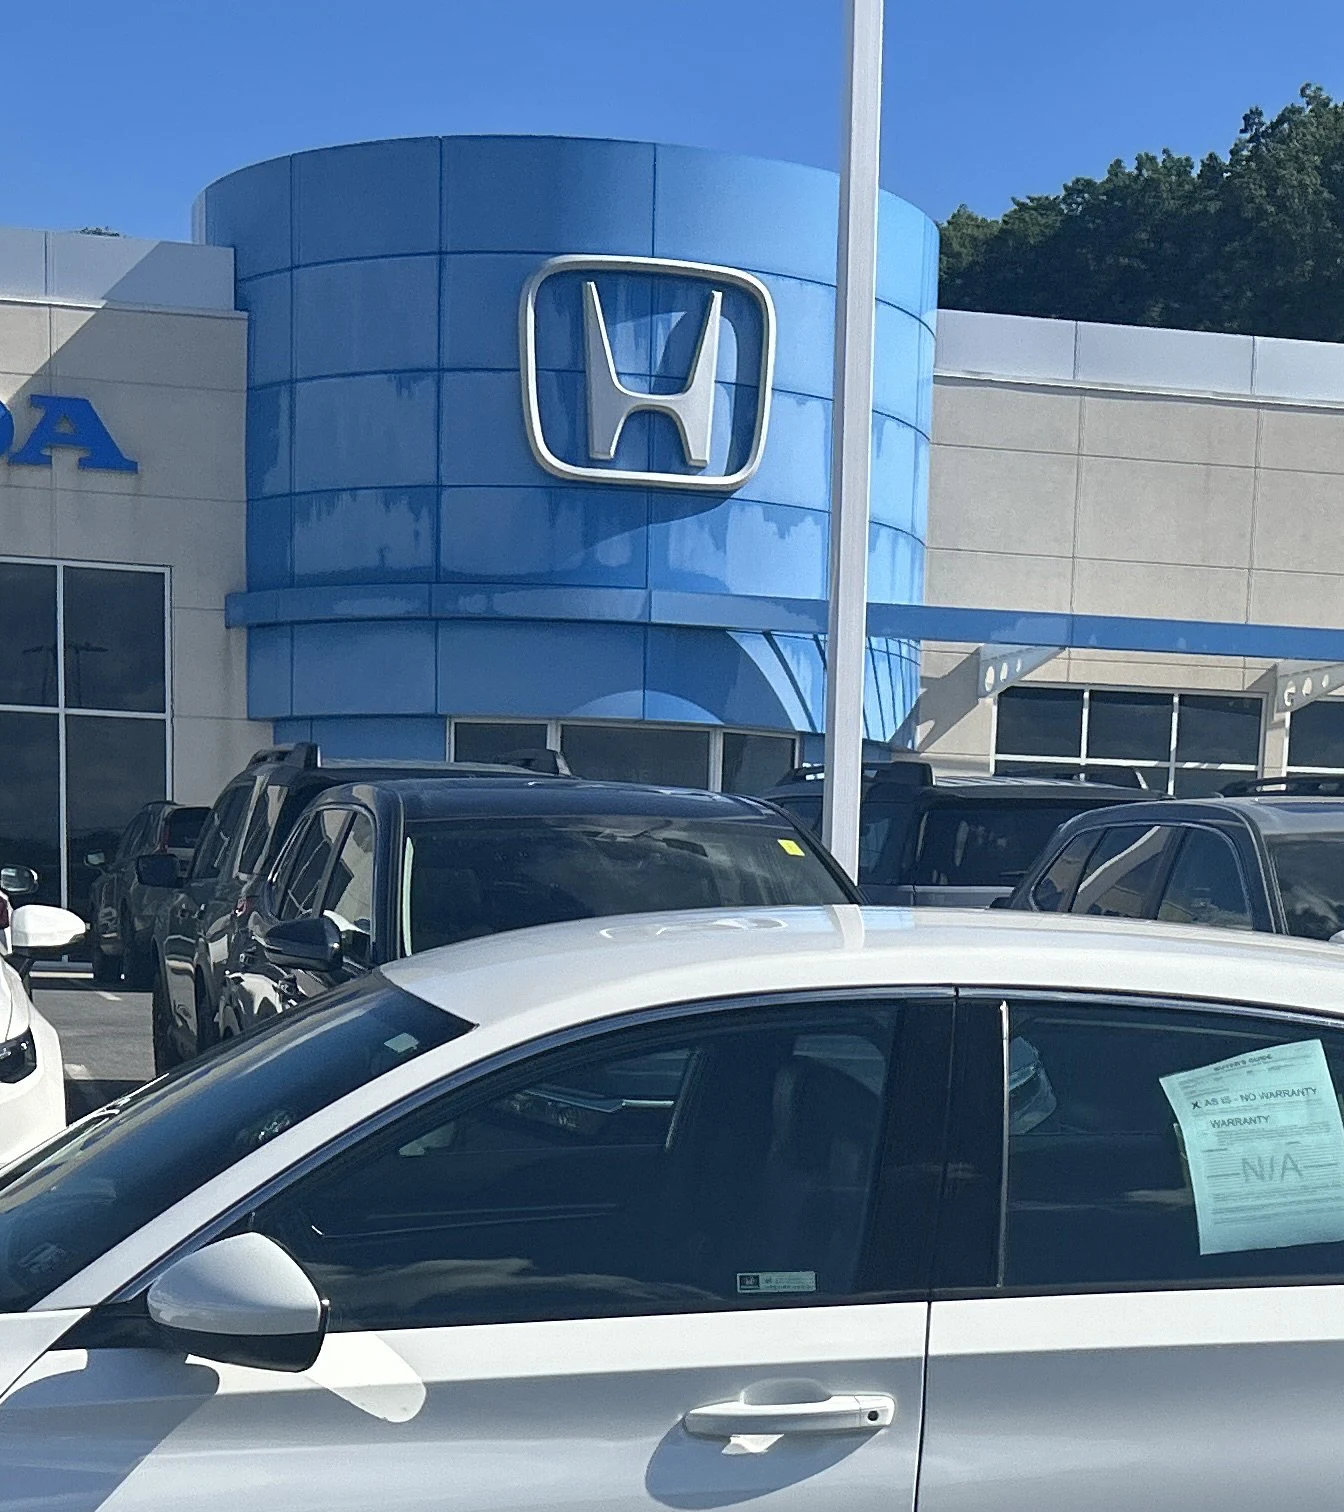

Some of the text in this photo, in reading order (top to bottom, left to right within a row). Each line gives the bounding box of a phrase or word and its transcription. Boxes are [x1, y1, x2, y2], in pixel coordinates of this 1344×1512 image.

[1205, 1096, 1219, 1107] AS
[1221, 1095, 1232, 1105] IS
[1240, 1092, 1256, 1103] NO
[1258, 1086, 1318, 1101] WARRANTY
[1210, 1115, 1270, 1129] WARRANTY
[1242, 1153, 1303, 1182] N/A
